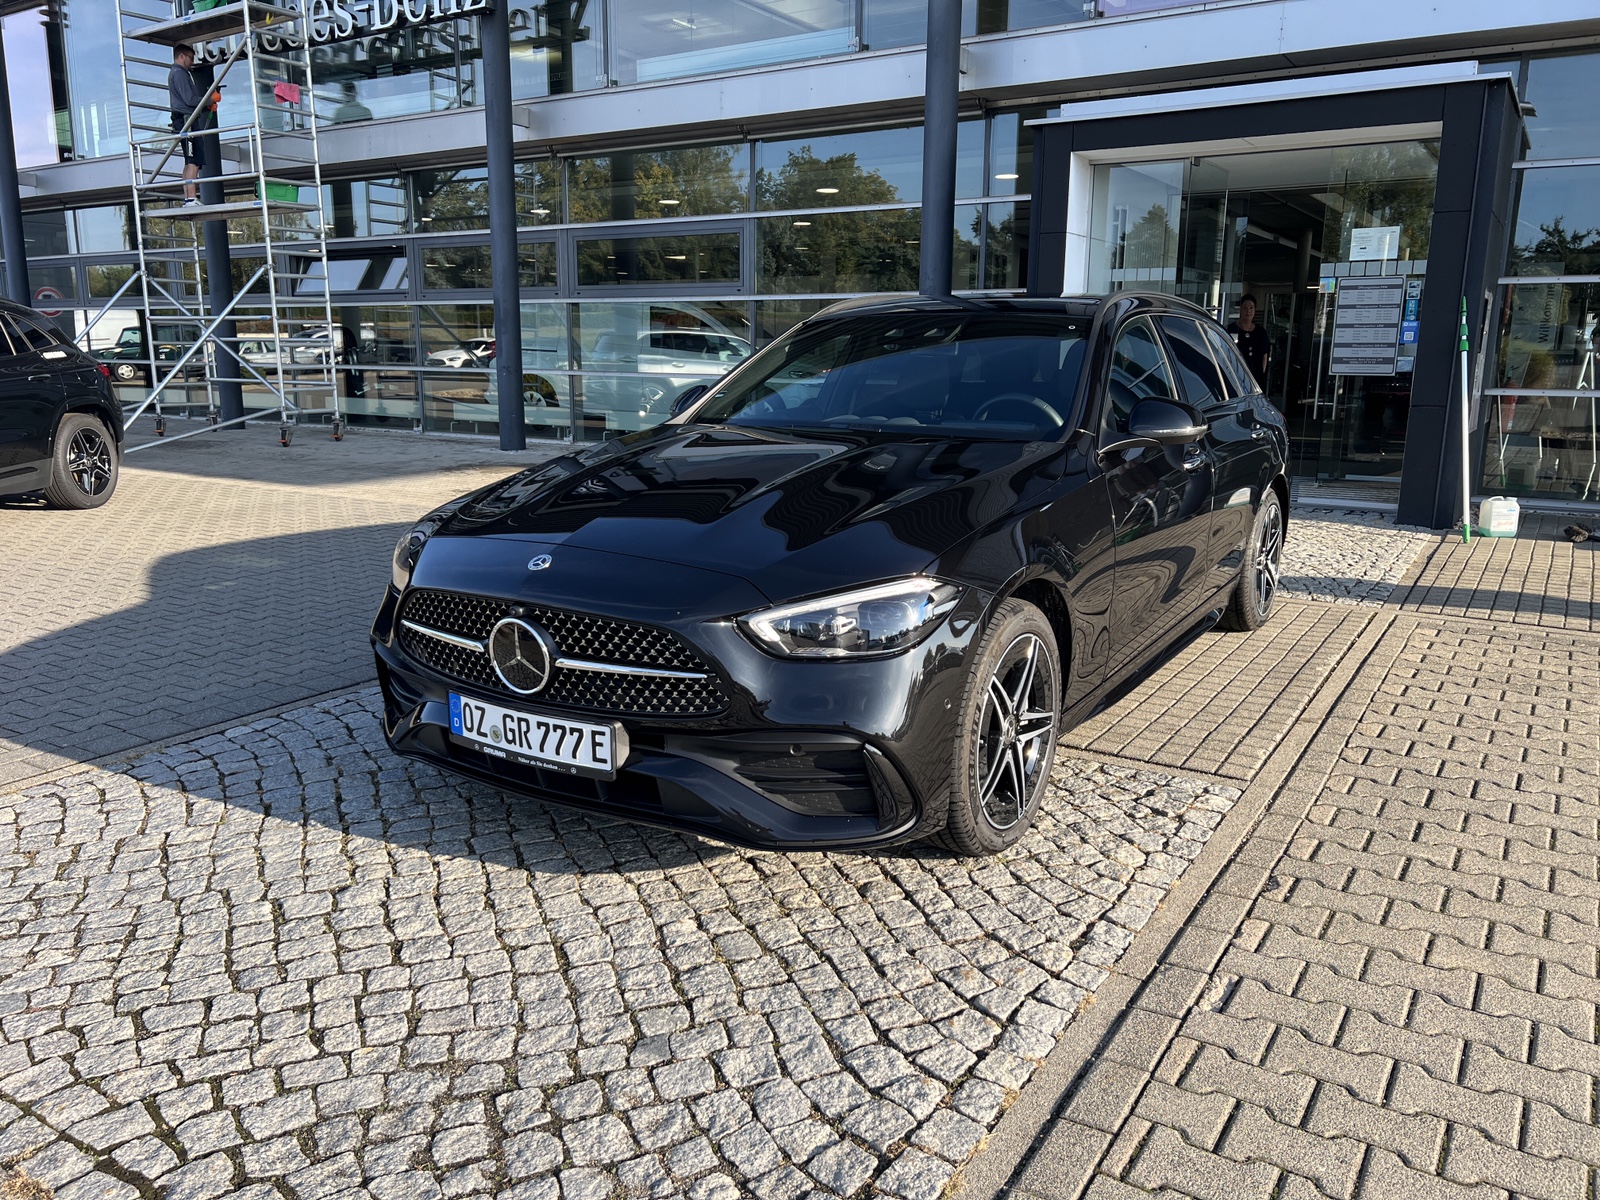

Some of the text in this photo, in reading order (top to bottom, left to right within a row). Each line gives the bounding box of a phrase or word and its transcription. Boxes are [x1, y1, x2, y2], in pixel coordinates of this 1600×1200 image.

[1538, 283, 1556, 344] Willkomme
[454, 717, 460, 727] D
[462, 702, 488, 738] OZ
